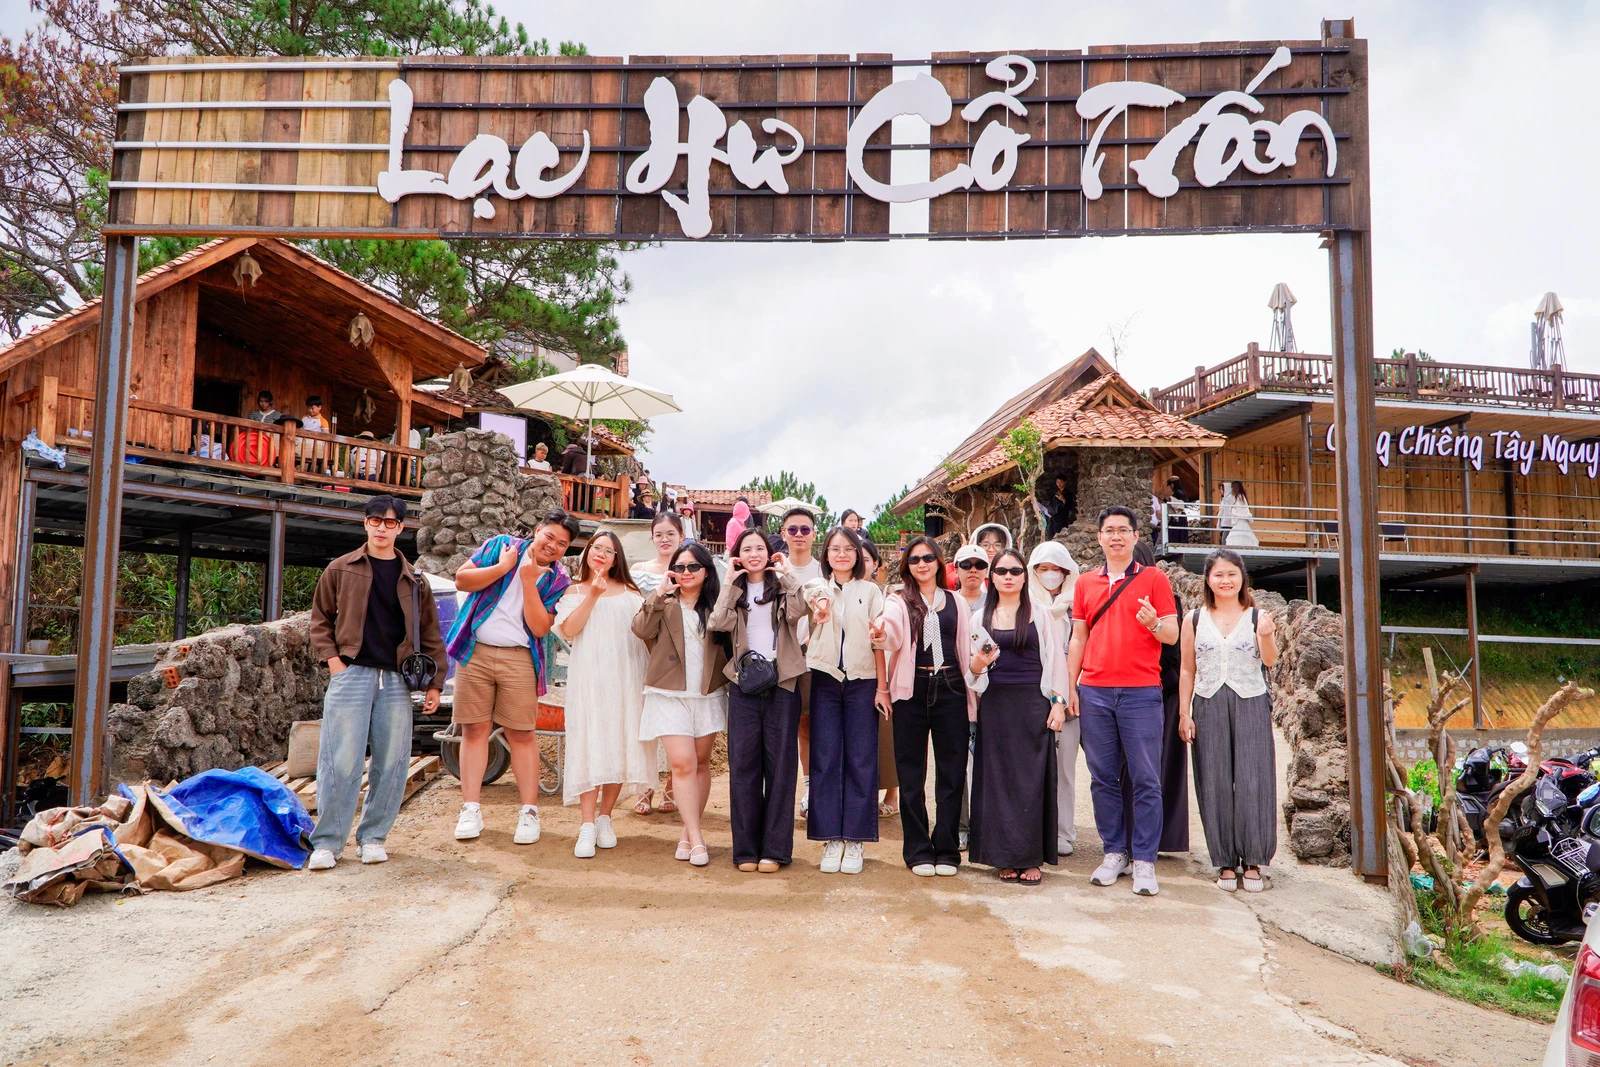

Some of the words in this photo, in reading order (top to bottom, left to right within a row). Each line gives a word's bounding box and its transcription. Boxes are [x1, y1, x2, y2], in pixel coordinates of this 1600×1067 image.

[378, 78, 591, 220] Lạc
[846, 54, 1036, 203] Cổ
[1076, 46, 1337, 200] Trấn
[1326, 423, 1391, 467] Cg
[1399, 425, 1483, 471] Chiêng
[1490, 430, 1535, 476] Tây
